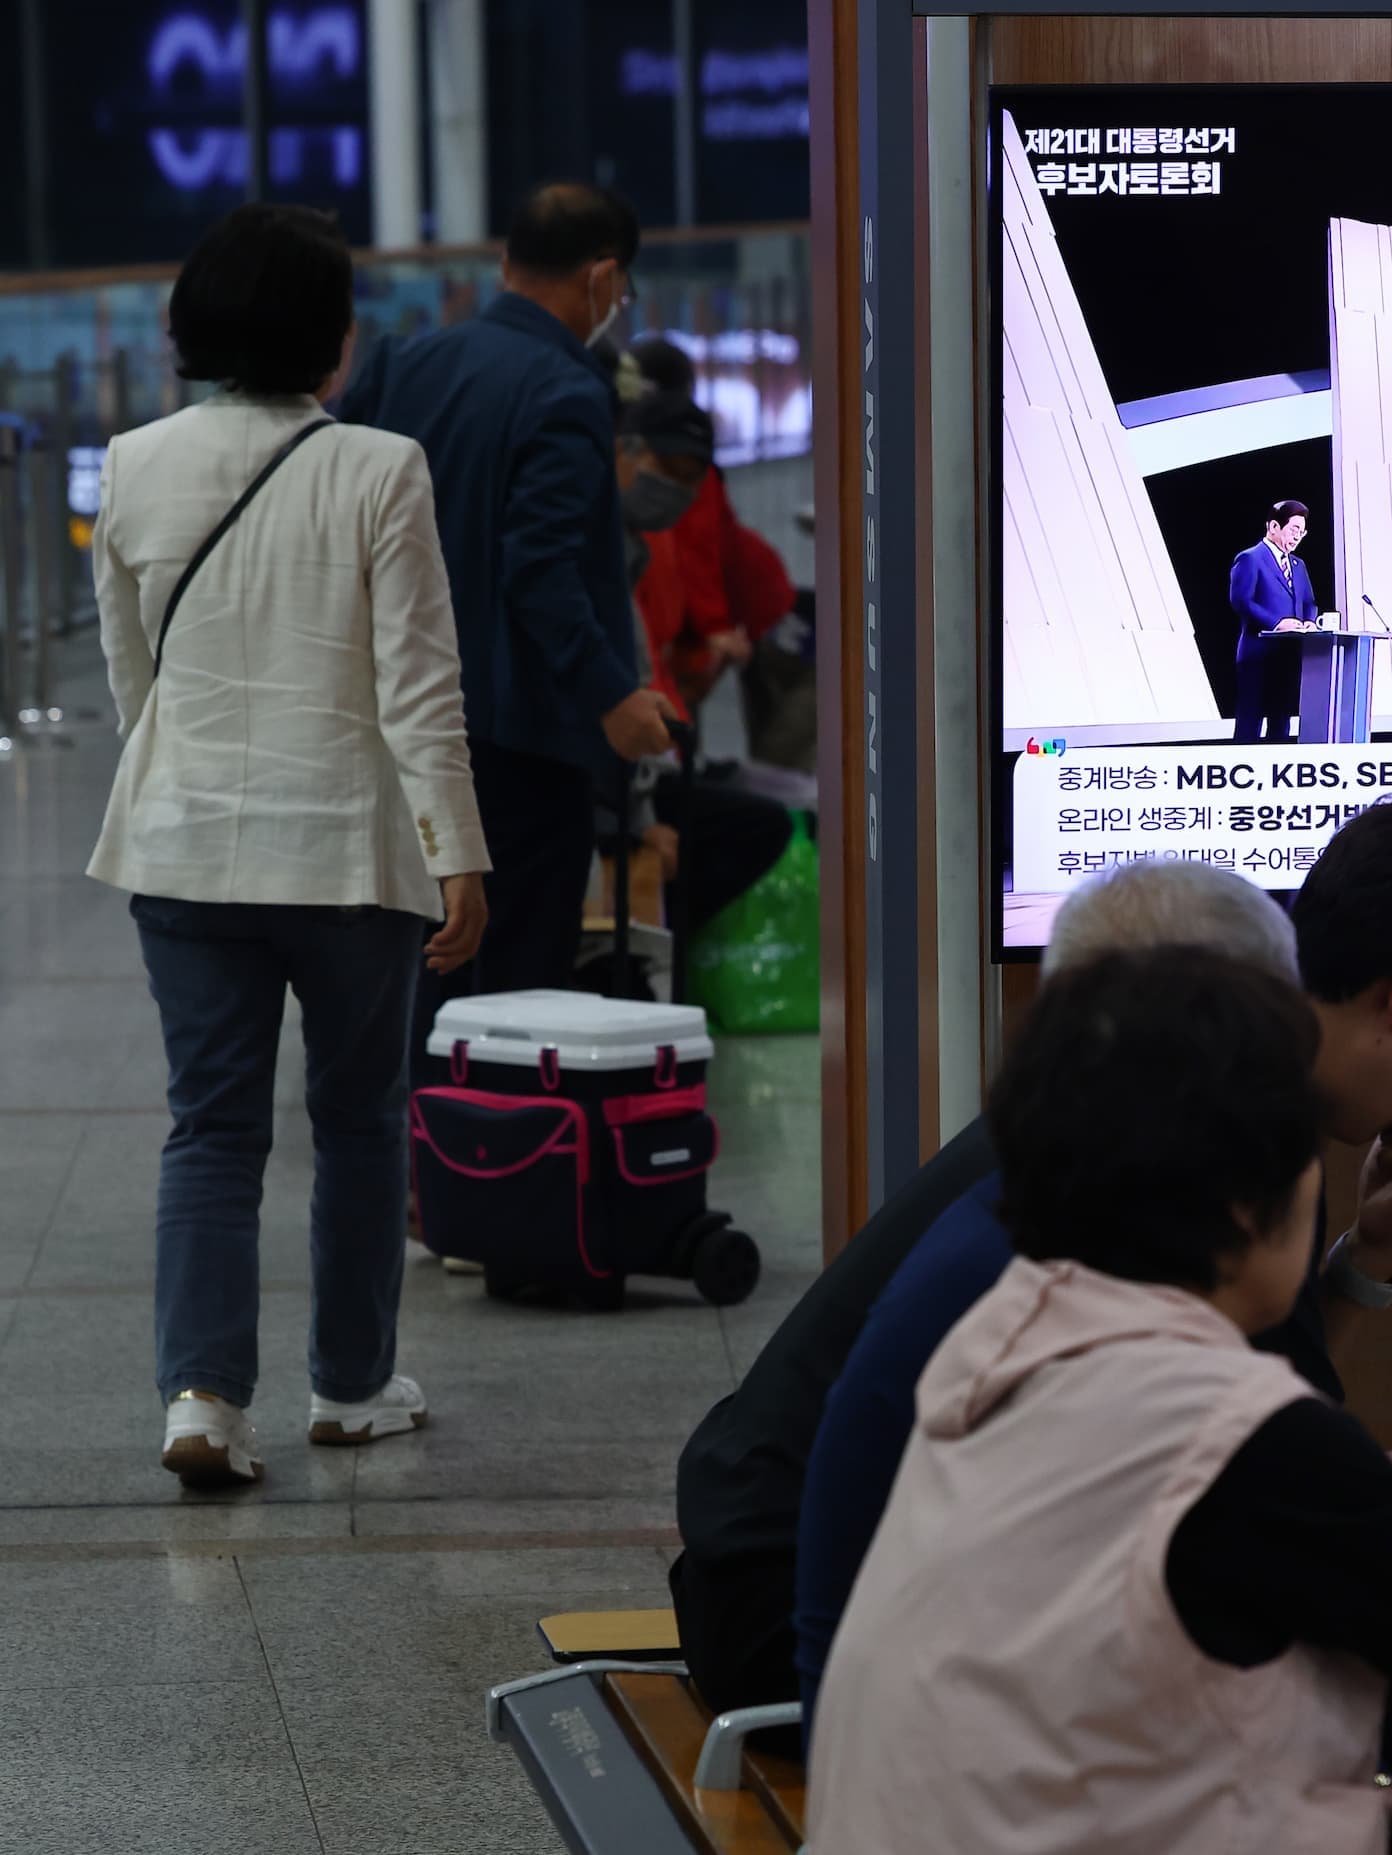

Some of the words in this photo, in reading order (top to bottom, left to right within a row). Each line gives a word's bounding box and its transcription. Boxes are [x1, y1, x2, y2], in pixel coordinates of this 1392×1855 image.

[1024, 128, 1100, 154] 제21대
[1106, 127, 1236, 154] 대통령선거
[1035, 161, 1221, 196] 후보자토론회
[864, 215, 877, 862] SAMSUNG
[1177, 763, 1263, 791] MBC,
[1272, 762, 1348, 790] KBS,
[1057, 807, 1132, 833] 온라인
[1242, 847, 1328, 872] 수어통
